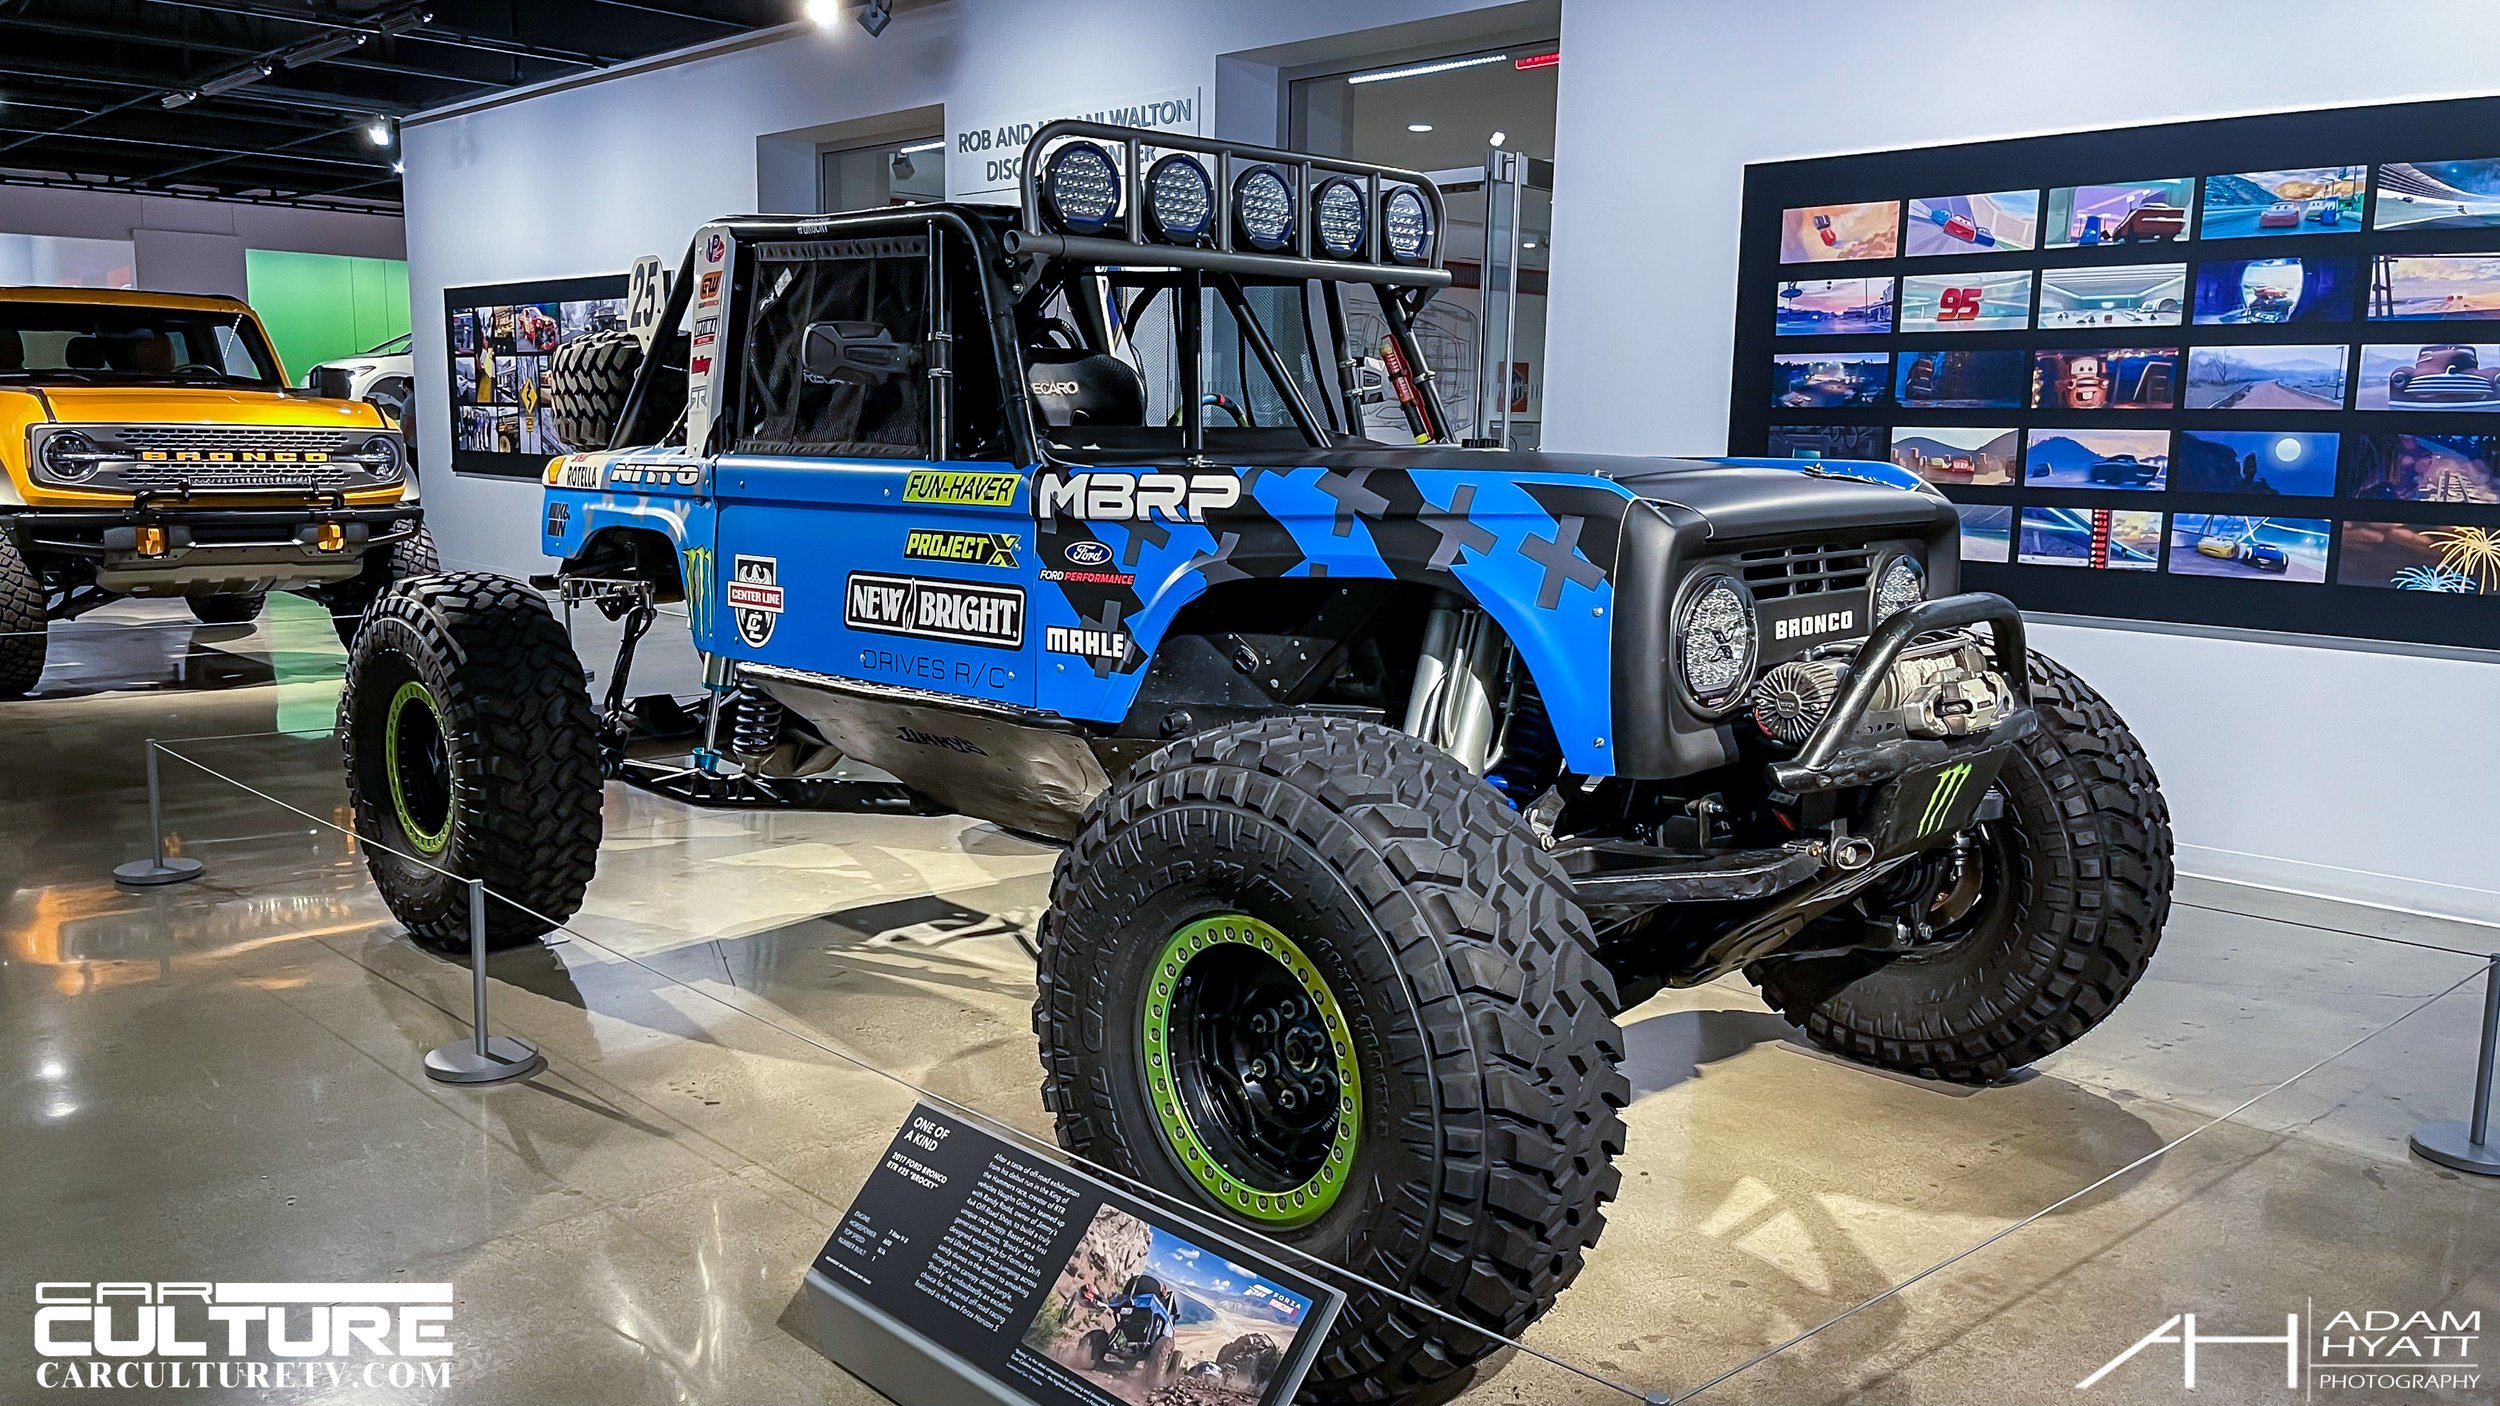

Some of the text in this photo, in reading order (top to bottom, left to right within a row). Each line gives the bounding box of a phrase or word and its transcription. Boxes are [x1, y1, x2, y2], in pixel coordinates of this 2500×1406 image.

[958, 130, 991, 153] ROB
[995, 124, 1032, 148] AND
[1109, 99, 1191, 127] WALTON
[630, 261, 658, 329] 25
[1937, 288, 1982, 321] 95
[1032, 382, 1079, 396] ECARO
[142, 451, 328, 462] BRONCO
[567, 463, 700, 488] ROTELLA NITTO
[906, 474, 1015, 502] FUN-HAVER
[1039, 473, 1241, 523] MBRP
[906, 533, 989, 560] PROJECT
[1073, 544, 1102, 563] Ford
[1039, 570, 1135, 585] FORD PERFORMANCE
[731, 588, 780, 605] CENTER LINE
[851, 585, 906, 623] NEW
[1046, 627, 1125, 658] MAHLE
[1775, 610, 1853, 640] BRONCO
[863, 650, 1005, 689] DRIVES R/C
[904, 1130, 938, 1151] A KIND
[913, 1117, 950, 1139] ONE OF
[886, 1160, 899, 1171] RTR
[897, 1166, 909, 1176] #25
[892, 1151, 947, 1183] 2017 FORD BRONCO
[988, 1161, 1000, 1172] from
[1001, 1167, 1009, 1176] his
[1008, 1172, 1025, 1183] debut
[1039, 1186, 1049, 1195] the
[1049, 1190, 1061, 1202] King
[994, 1153, 1007, 1163] After
[1010, 1161, 1023, 1171] taste
[1050, 1180, 1080, 1197] exhilaration
[972, 1190, 983, 1198] with
[983, 1194, 999, 1207] Randy
[1014, 1211, 1030, 1221] owner
[977, 1181, 997, 1194] vehicles
[997, 1189, 1016, 1203] Vaughn
[1016, 1198, 1030, 1210] Gittin
[1037, 1209, 1058, 1223] teamed
[983, 1171, 992, 1179] the
[992, 1175, 1015, 1191] Hammers
[1028, 1194, 1047, 1205] creator
[1053, 1204, 1065, 1214] RTR
[954, 1217, 981, 1234] generation
[1024, 1253, 1034, 1261] was
[960, 1208, 978, 1220] unique
[978, 1217, 989, 1225] race
[1007, 1230, 1025, 1243] Based
[1035, 1244, 1047, 1255] first
[967, 1198, 976, 1206] 4x4
[1019, 1224, 1035, 1236] build
[1038, 1234, 1051, 1246] truly
[943, 1235, 955, 1243] and
[953, 1239, 969, 1251] Ultra4
[985, 1256, 999, 1267] From
[997, 1264, 1020, 1281] jumping
[1020, 1276, 1037, 1288] across
[949, 1225, 1041, 1277] designed specifically for Formula Drift
[932, 1253, 951, 1267] through
[951, 1263, 960, 1272] the
[960, 1269, 979, 1283] canopy
[979, 1278, 995, 1291] dense
[938, 1244, 953, 1256] sandy
[952, 1252, 968, 1263] dunes
[973, 1262, 982, 1271] the
[982, 1267, 999, 1280] desert
[1004, 1280, 1029, 1298] smashing
[914, 1279, 936, 1295] featured
[940, 1295, 949, 1303] the
[949, 1301, 960, 1309] new
[959, 1305, 974, 1318] Forza
[973, 1314, 994, 1329] Horizon
[920, 1272, 936, 1284] choice
[936, 1279, 944, 1287] for
[944, 1284, 953, 1293] the
[953, 1290, 970, 1302] varied
[988, 1310, 1005, 1324] racing
[951, 1277, 983, 1298] undoubtedly
[990, 1298, 1013, 1314] excellent
[1273, 1292, 1301, 1309] FORZA
